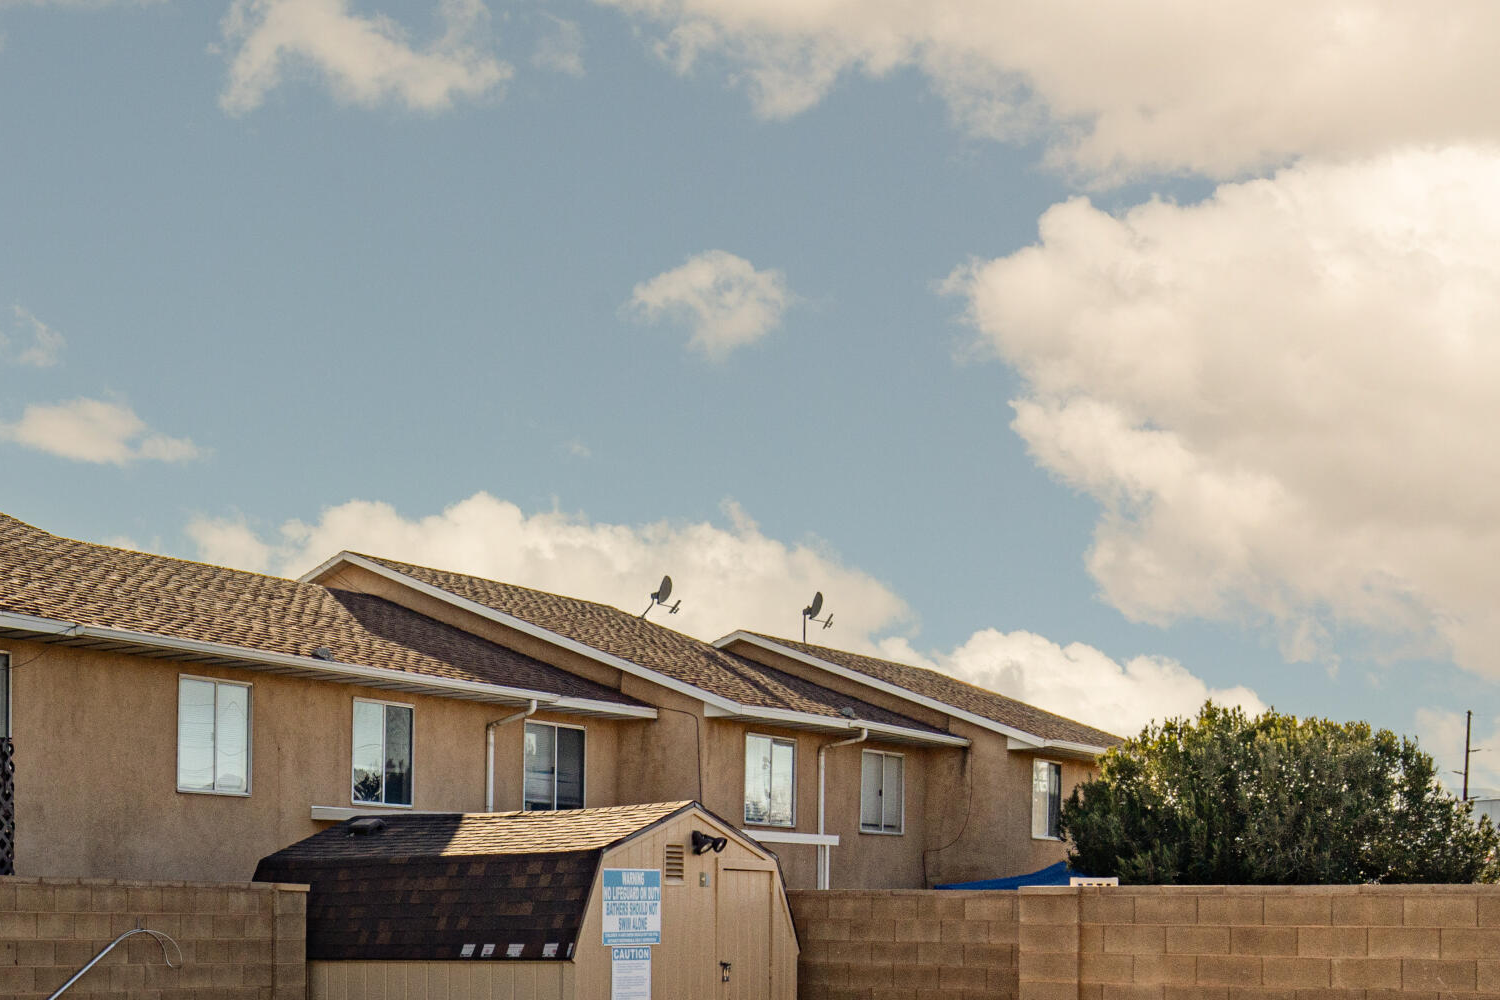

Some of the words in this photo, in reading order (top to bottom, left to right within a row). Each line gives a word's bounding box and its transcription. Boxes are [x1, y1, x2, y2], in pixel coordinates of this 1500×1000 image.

[622, 872, 644, 885] WARNING
[604, 887, 612, 901] NO
[612, 887, 639, 901] LIFEGUARD
[640, 887, 648, 901] ON
[648, 886, 660, 900] DUTY
[606, 903, 628, 916] BATHERS
[630, 903, 647, 916] SHOULD
[649, 903, 658, 915] NOT
[619, 917, 631, 930] SWIM
[633, 917, 647, 930] ALONE
[613, 949, 649, 959] CAUTION
